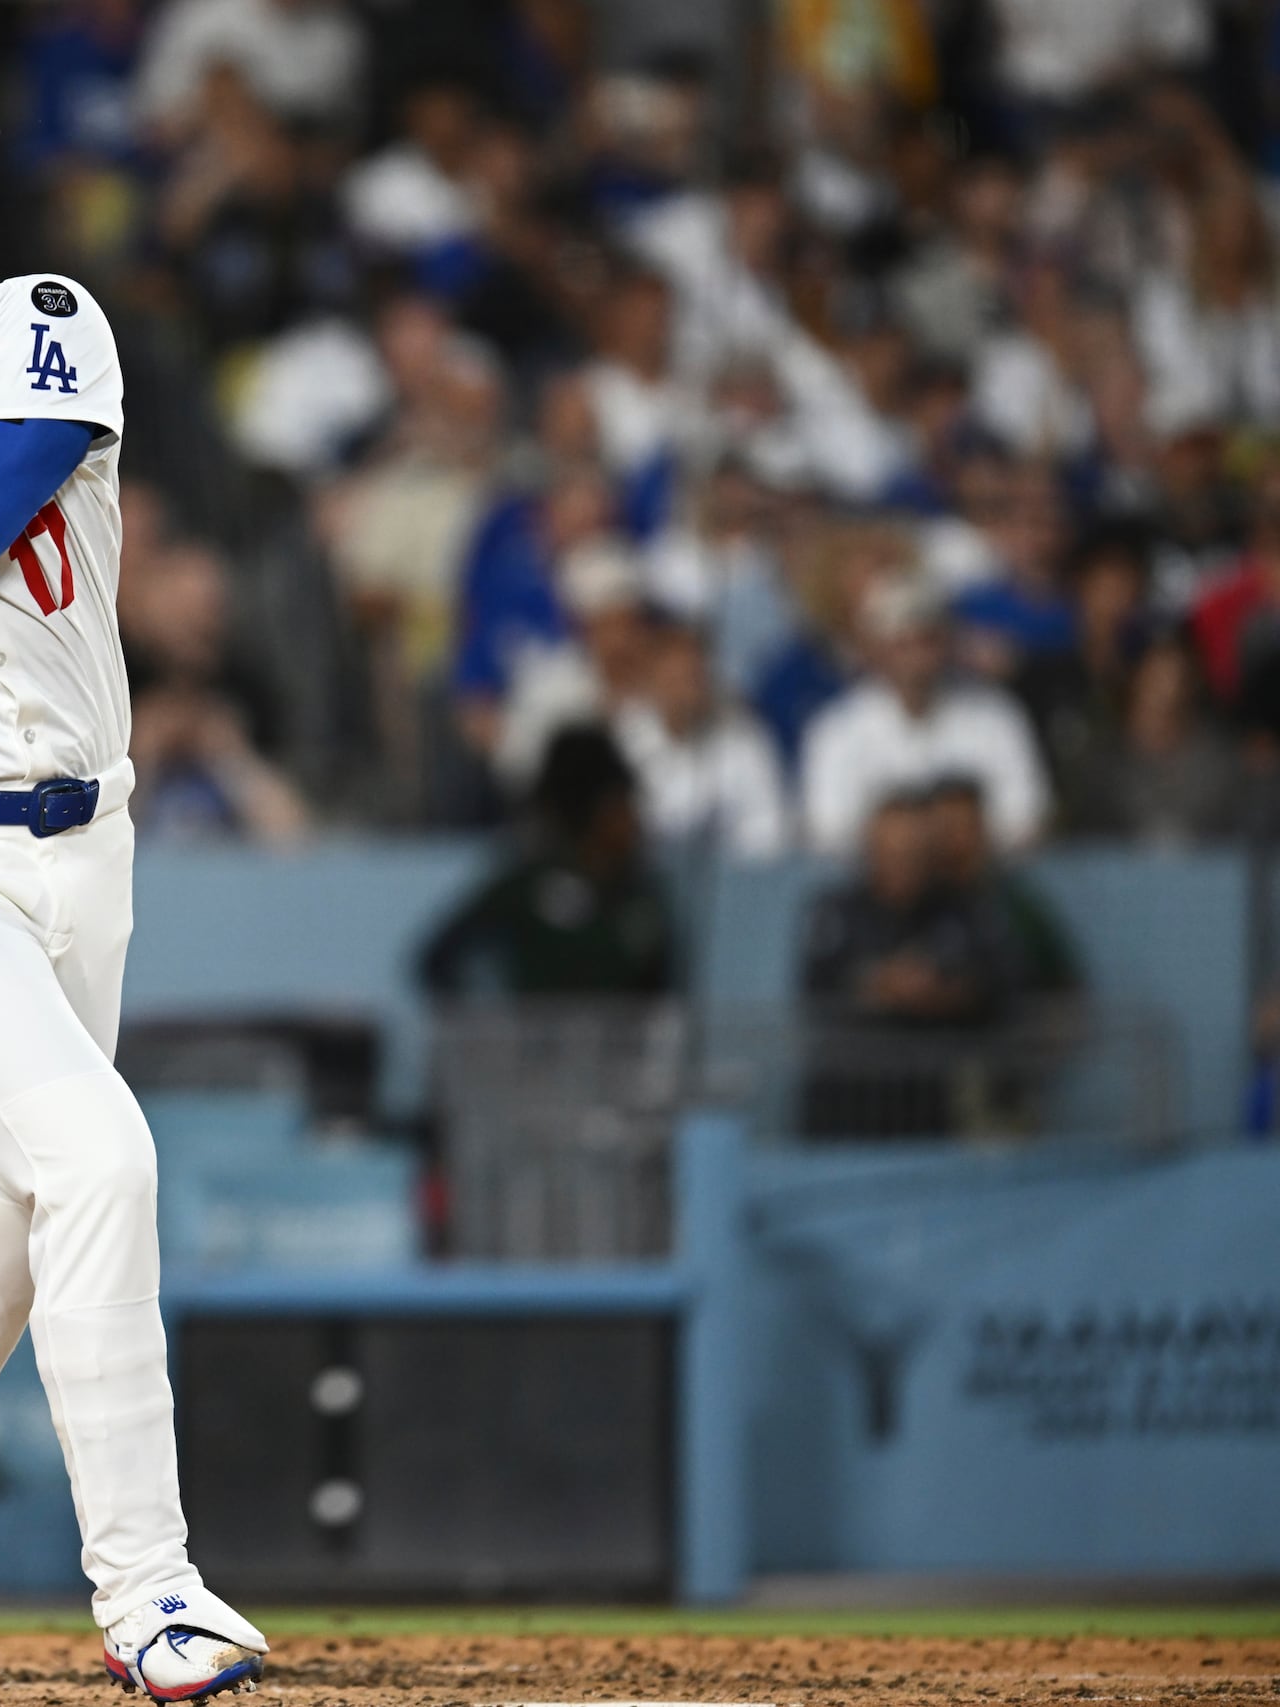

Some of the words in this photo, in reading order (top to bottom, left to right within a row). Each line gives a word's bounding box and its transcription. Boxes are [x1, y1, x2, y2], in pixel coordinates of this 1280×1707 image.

[41, 293, 71, 312] 34
[26, 322, 79, 394] LA
[9, 500, 75, 617] 17
